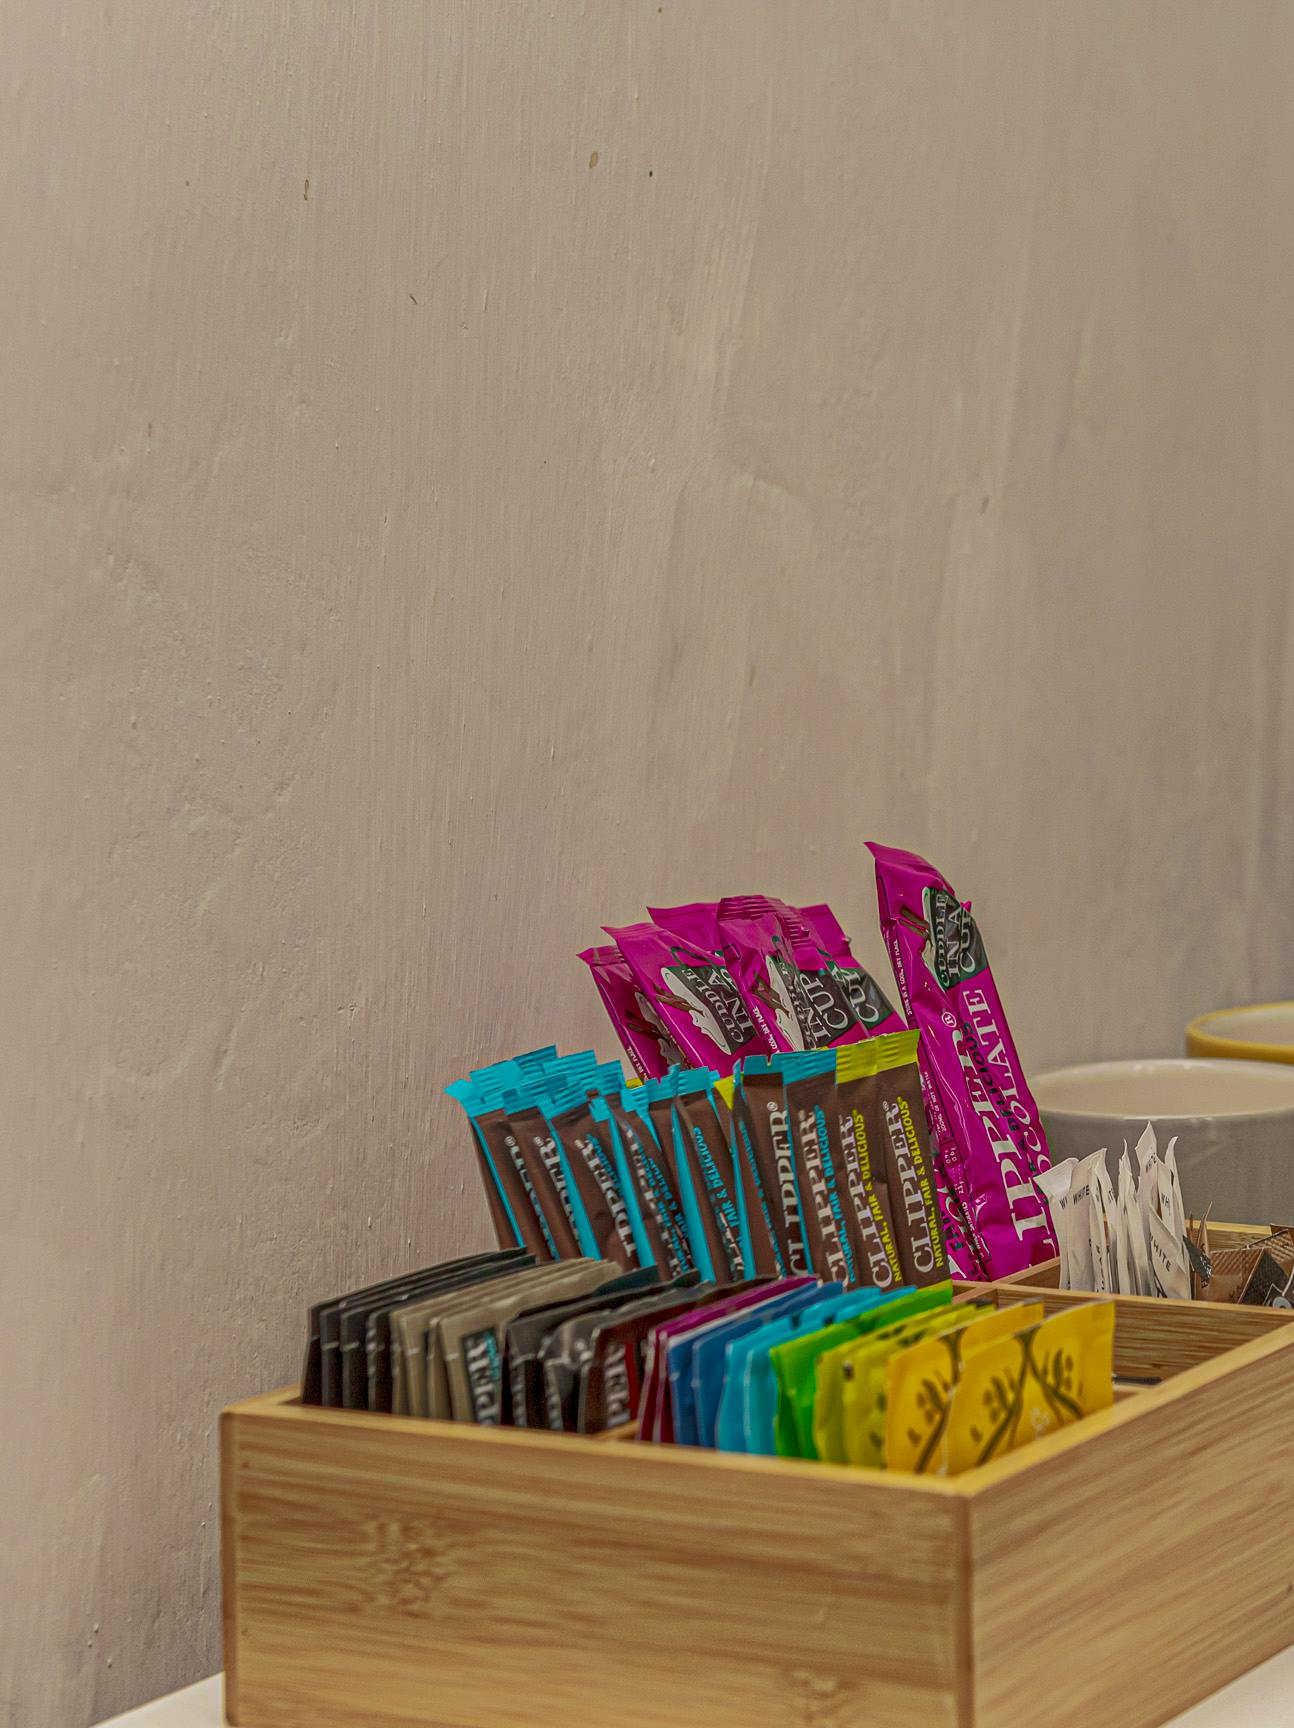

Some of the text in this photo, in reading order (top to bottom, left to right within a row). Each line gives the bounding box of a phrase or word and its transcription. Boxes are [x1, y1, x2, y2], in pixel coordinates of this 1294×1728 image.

[708, 968, 731, 990] A
[947, 940, 960, 977] IN
[681, 968, 744, 1042] CUDDLE
[800, 973, 849, 1029] CUP
[963, 988, 1052, 1176] OCOLATE
[840, 1116, 893, 1288] CLIPPER
[869, 1194, 885, 1224] FAIR
[885, 1102, 935, 1273] CLIPPER
[919, 1178, 934, 1205] FAIR
